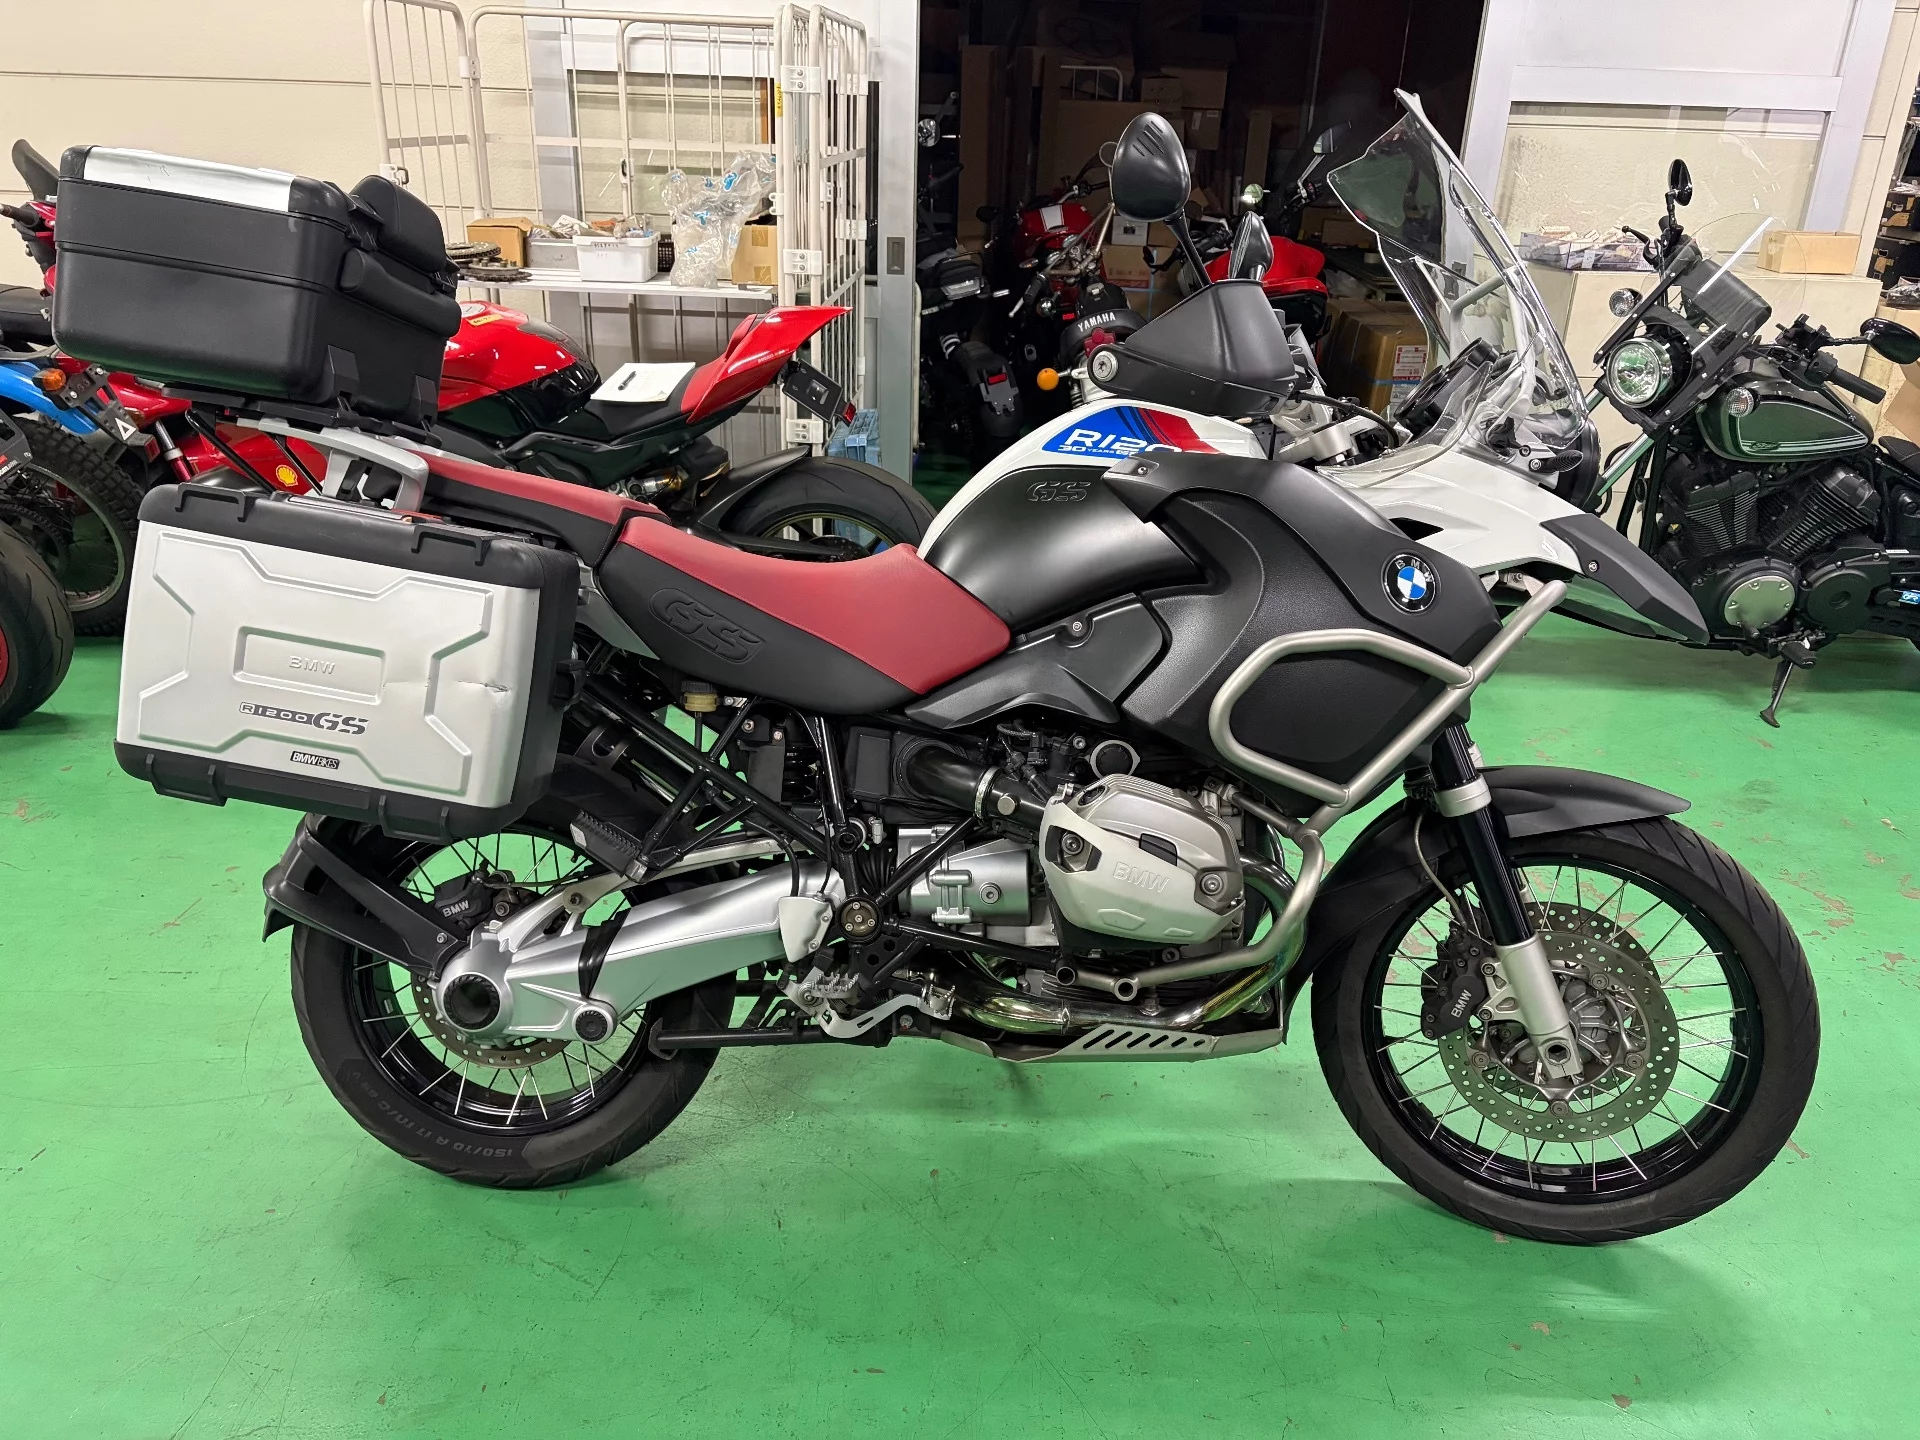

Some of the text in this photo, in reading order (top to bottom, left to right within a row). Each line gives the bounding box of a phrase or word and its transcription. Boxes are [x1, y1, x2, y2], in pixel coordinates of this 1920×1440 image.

[1077, 311, 1116, 332] YAMAHA
[1064, 428, 1221, 453] R12
[1025, 481, 1092, 502] GS
[1395, 559, 1433, 583] BMW
[649, 588, 765, 663] GS
[289, 655, 336, 675] BMW
[1112, 860, 1171, 893] BMW
[442, 899, 470, 918] BMW
[1450, 988, 1472, 1018] BMW
[416, 1127, 433, 1138] 17
[453, 1142, 513, 1158] 150/70
